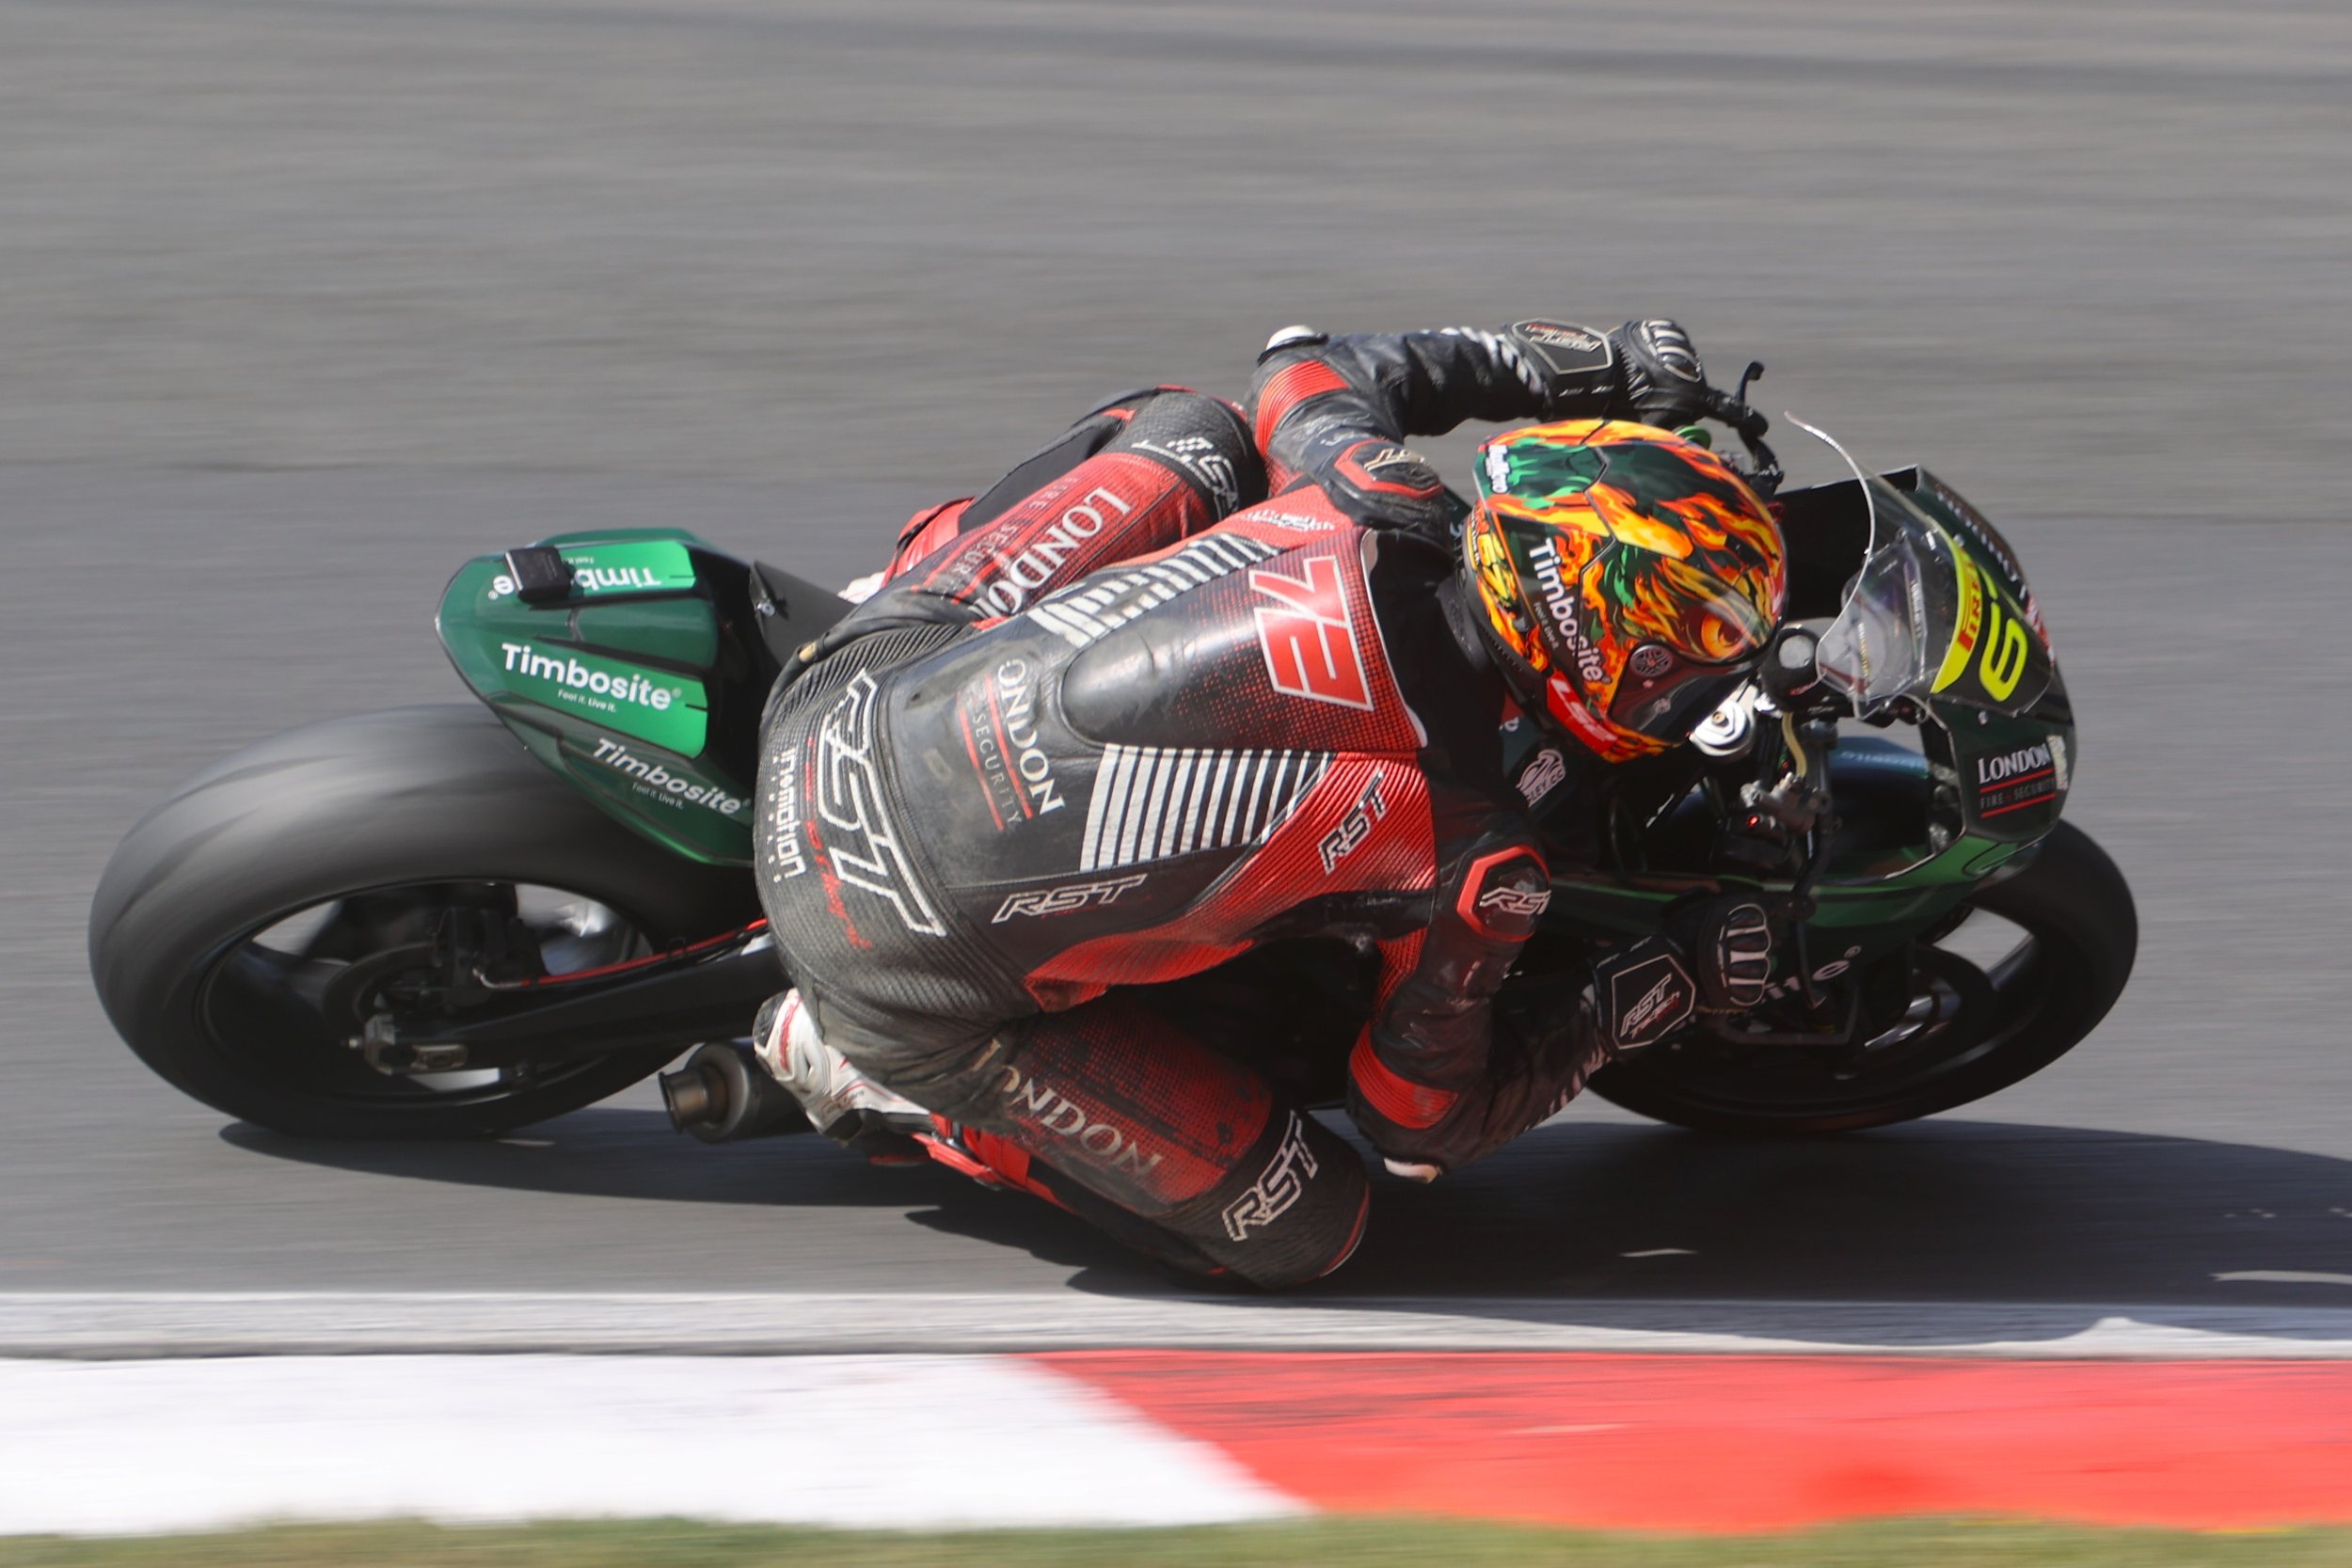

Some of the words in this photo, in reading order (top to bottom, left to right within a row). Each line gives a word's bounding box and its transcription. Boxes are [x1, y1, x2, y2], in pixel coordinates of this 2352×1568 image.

[1530, 537, 1603, 681] Timbosite
[1979, 566, 2029, 703] 6
[501, 642, 672, 710] Timbosite
[593, 737, 741, 815] Timbosite
[972, 713, 1022, 823] SECURITY
[997, 658, 1066, 816] ONDON
[1978, 742, 2051, 784] LONDON
[1317, 767, 1387, 876] RST
[991, 873, 1149, 925] RST
[1619, 973, 1673, 1038] RST
[1222, 1108, 1319, 1242] RST
